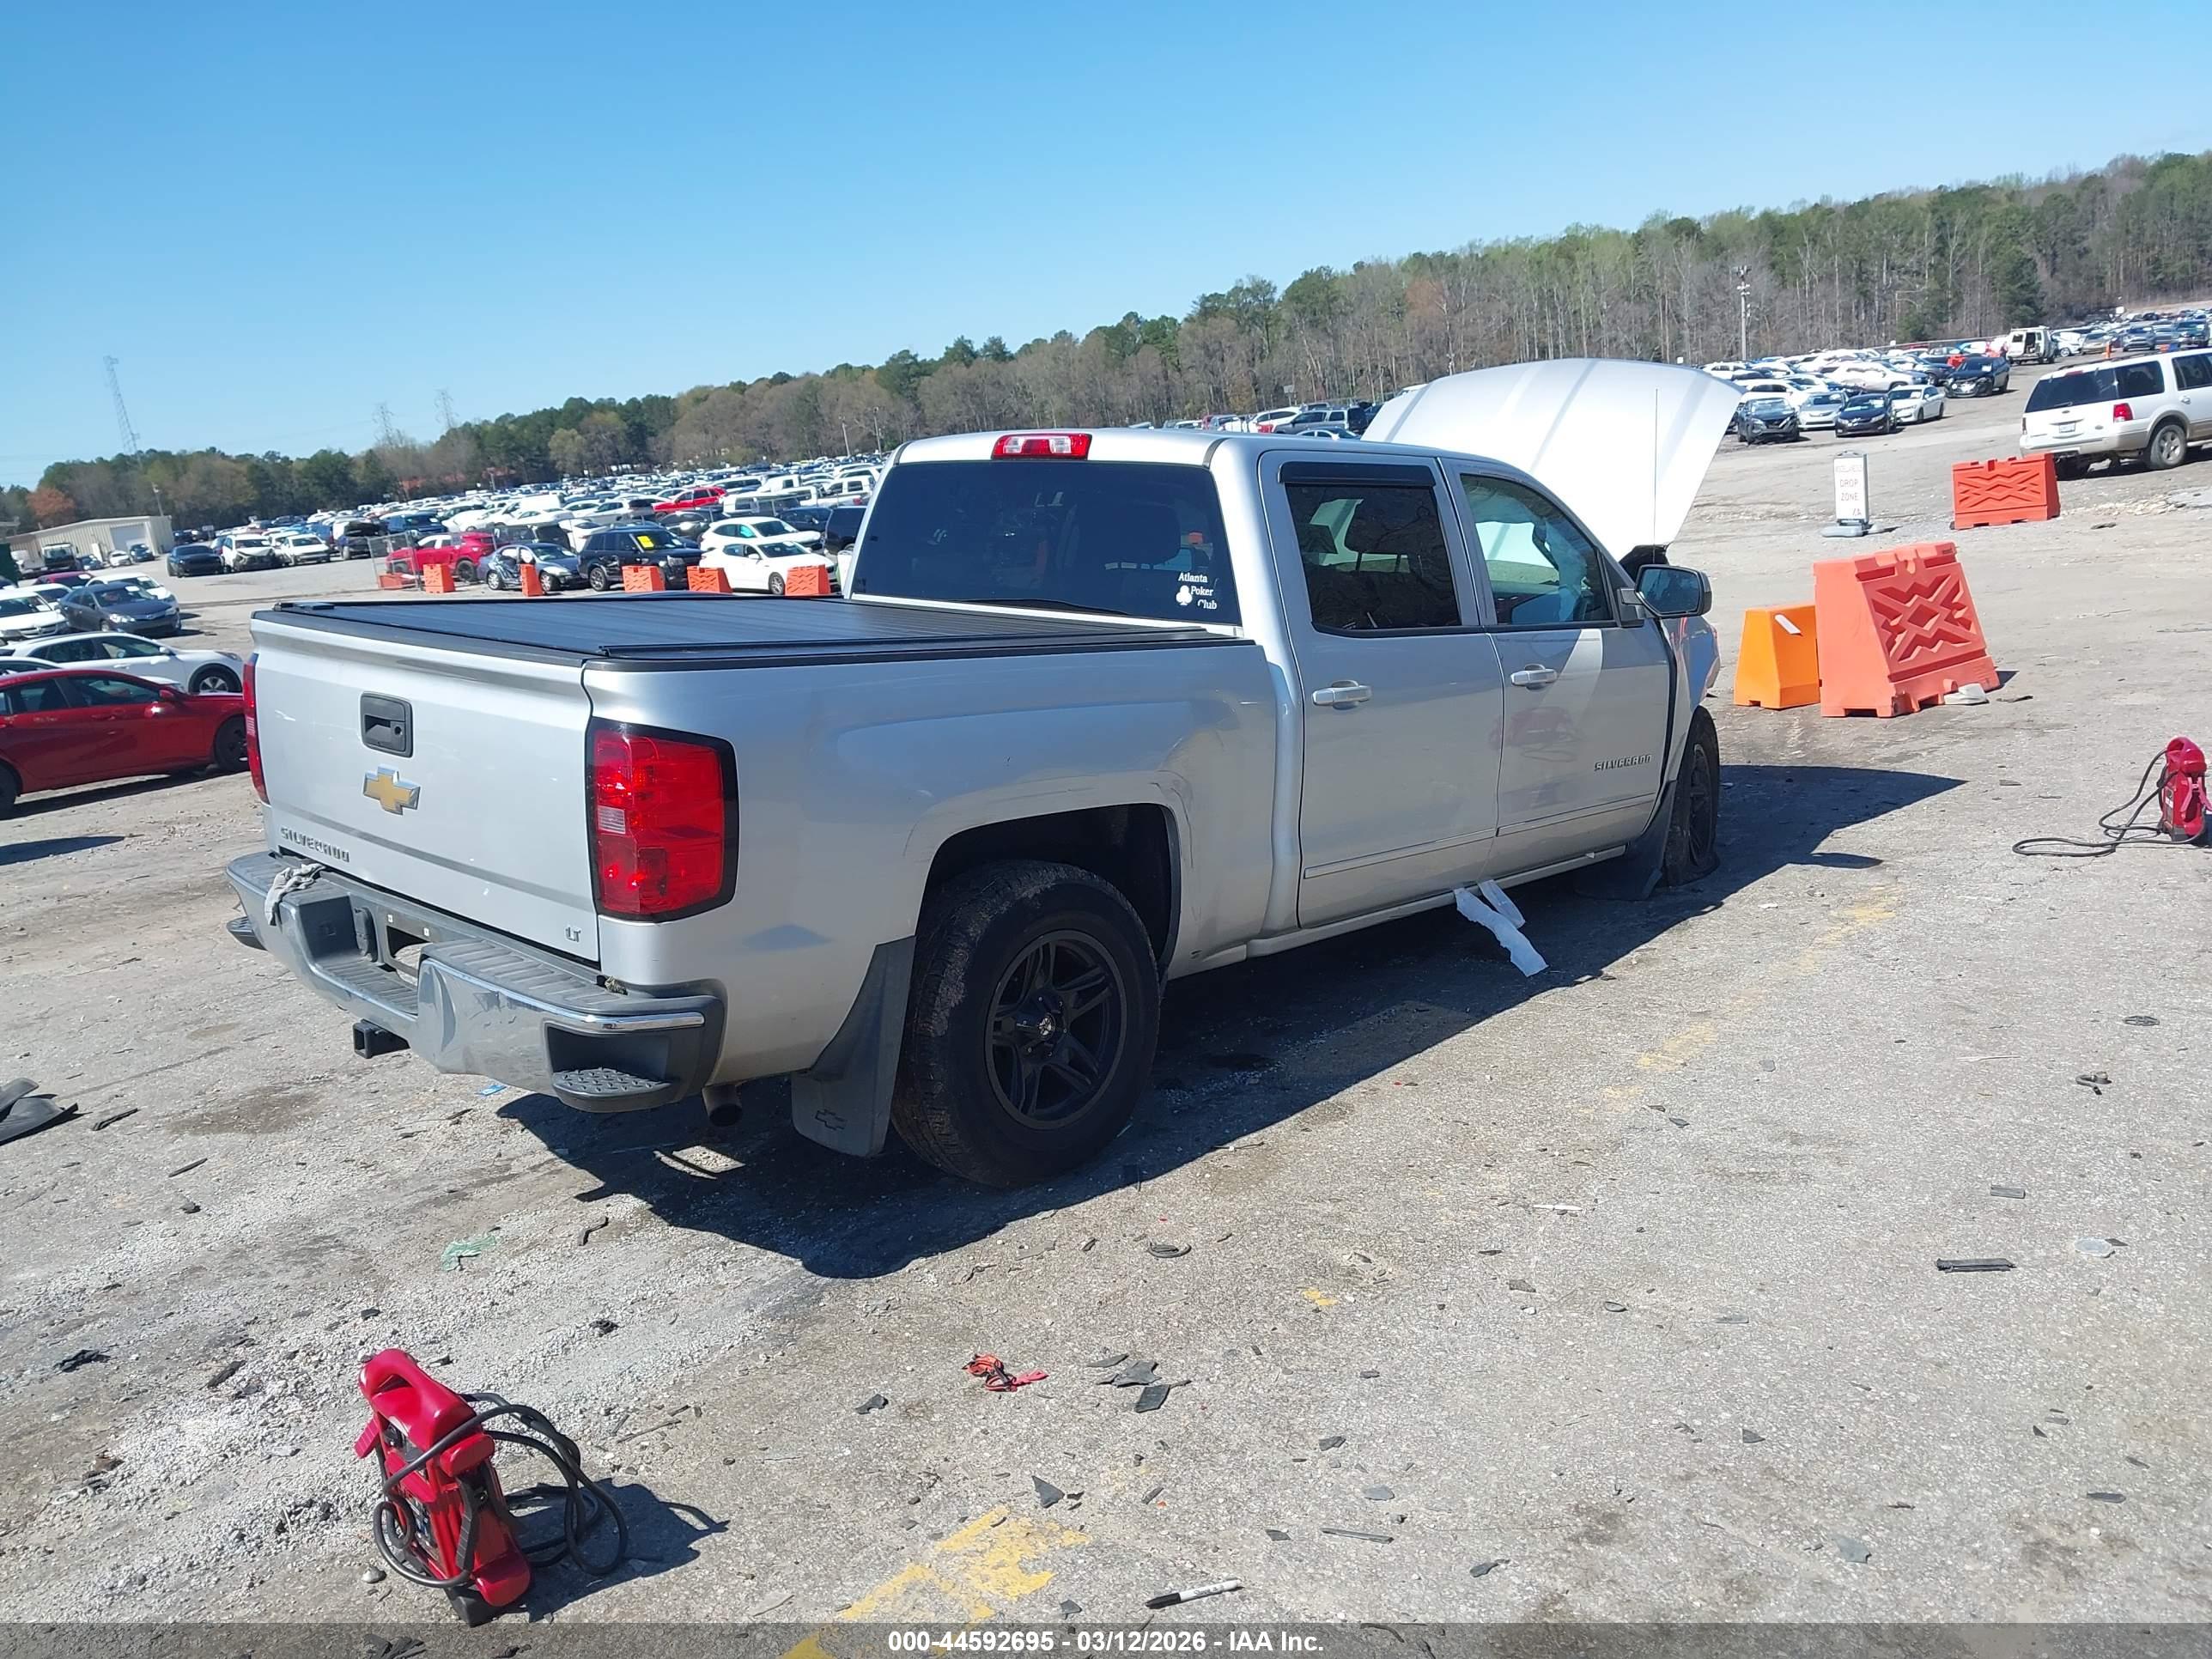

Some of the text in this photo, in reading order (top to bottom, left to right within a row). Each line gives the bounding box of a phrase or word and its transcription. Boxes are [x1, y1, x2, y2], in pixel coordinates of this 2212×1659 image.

[1839, 479, 1858, 488] DROP
[1840, 492, 1859, 501] ZONE
[1177, 572, 1208, 583] Atlanta
[1191, 586, 1214, 596] Poker
[1594, 753, 1653, 772] SILVERADO
[565, 927, 581, 943] LT
